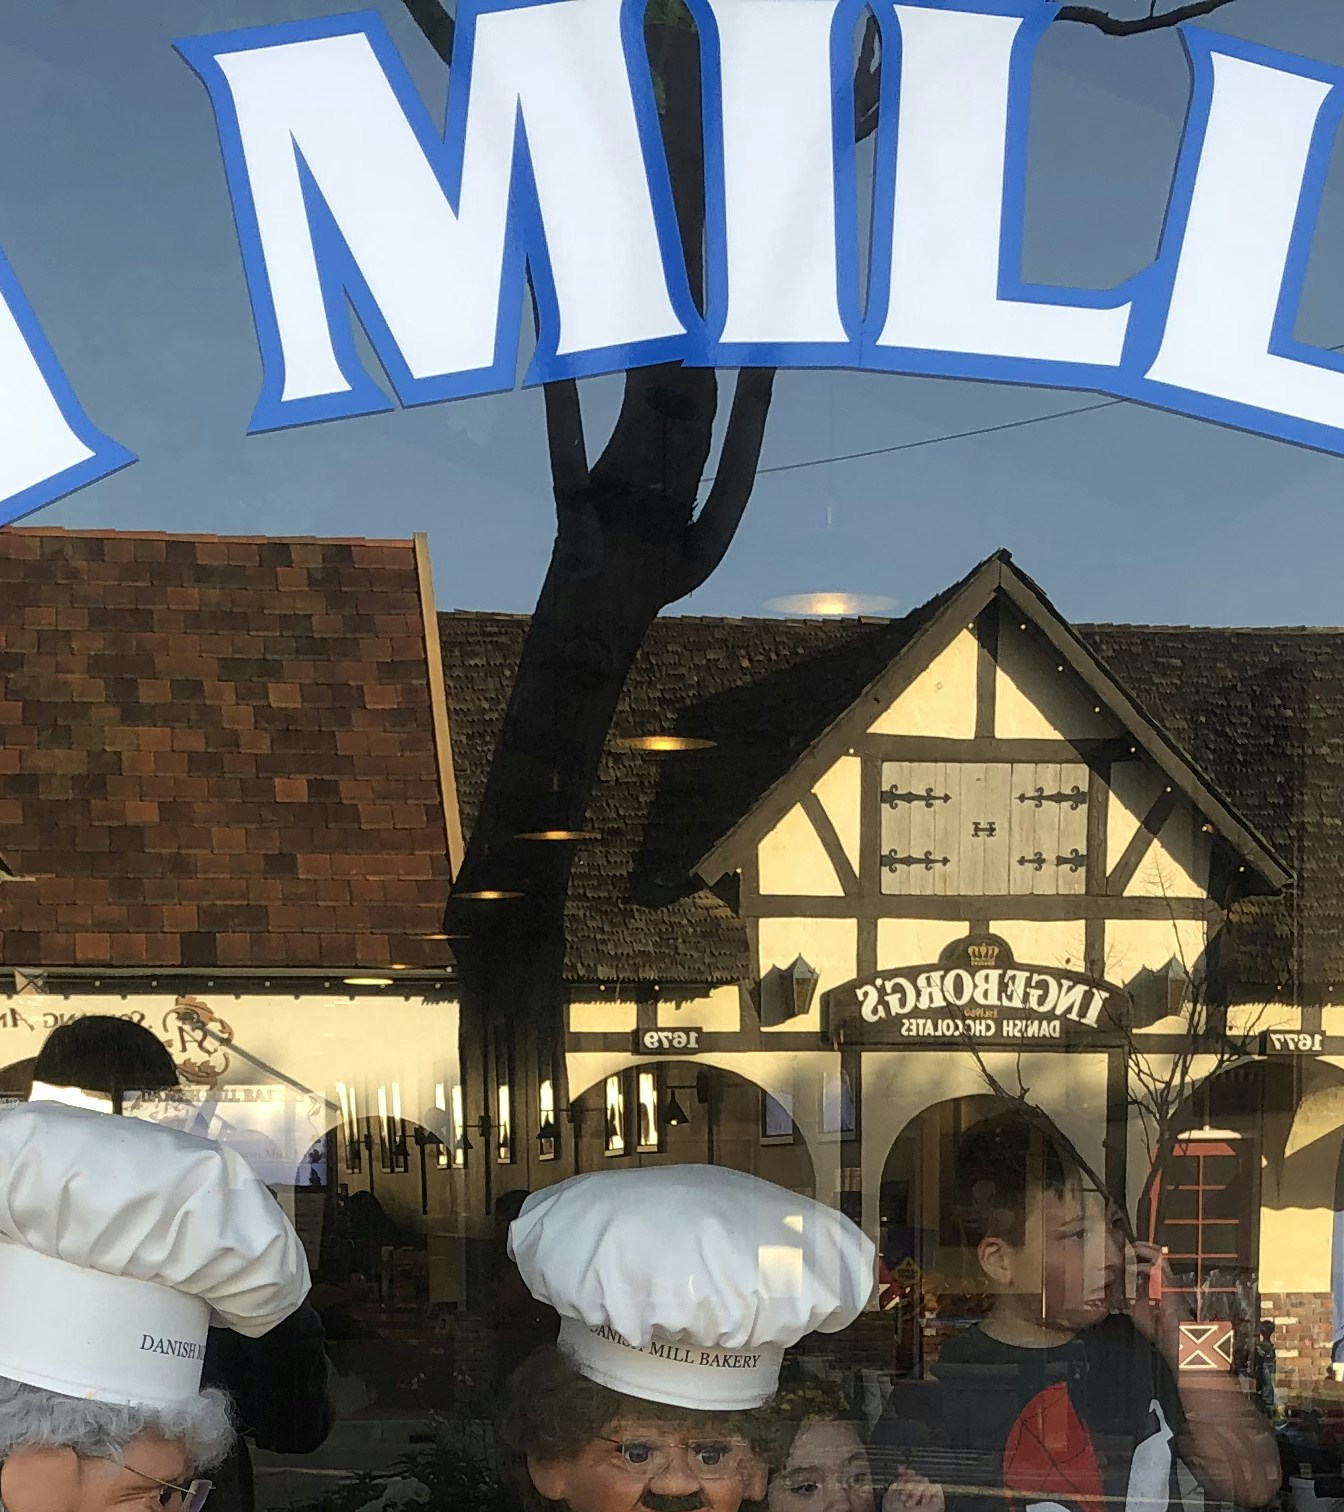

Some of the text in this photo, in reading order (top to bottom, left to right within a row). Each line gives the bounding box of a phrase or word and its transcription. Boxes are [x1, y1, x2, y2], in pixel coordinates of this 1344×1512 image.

[139, 1333, 197, 1360] DANISH
[648, 1341, 695, 1364] MILL
[699, 1351, 761, 1369] BAKERY
